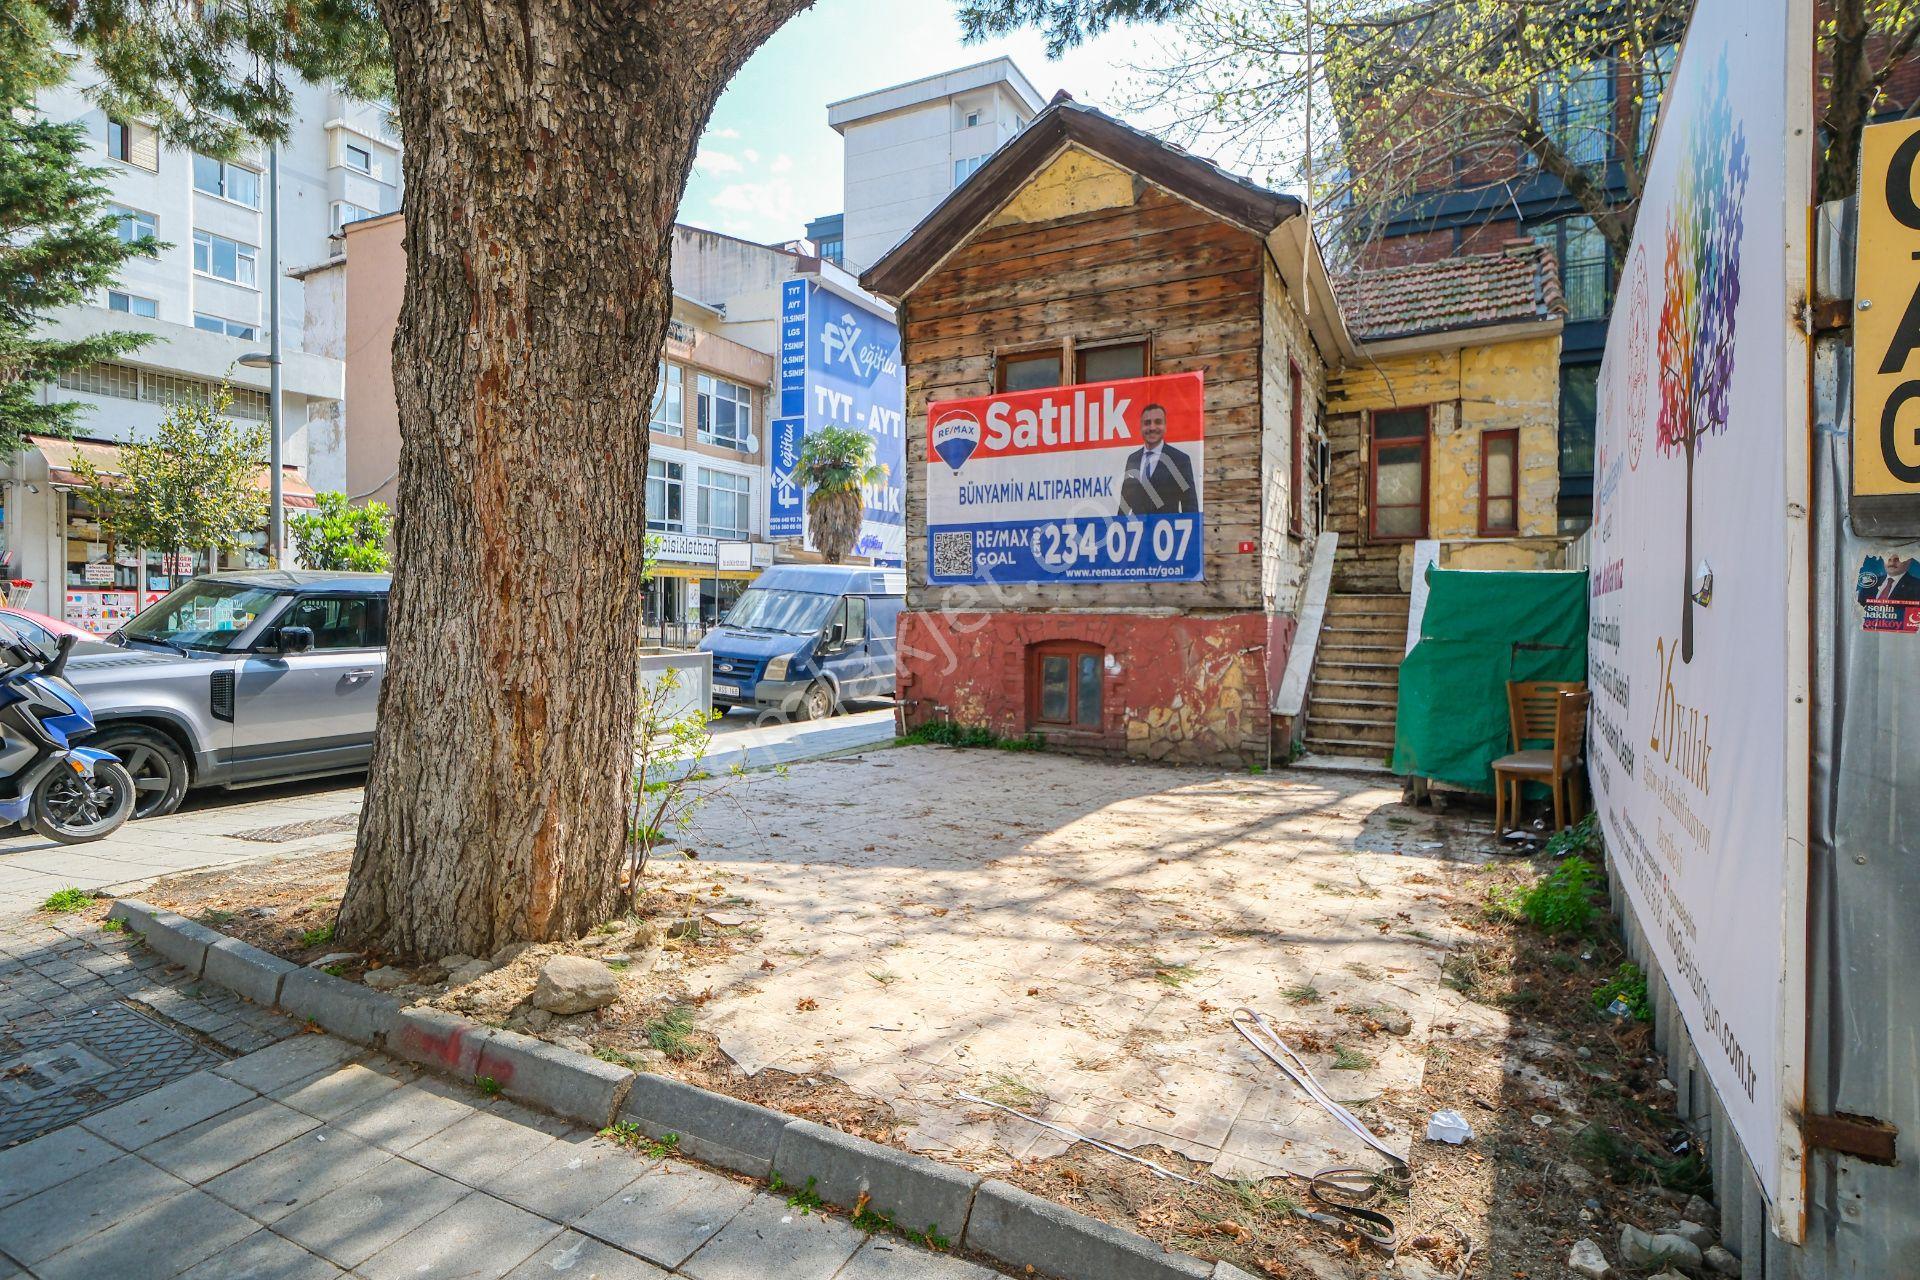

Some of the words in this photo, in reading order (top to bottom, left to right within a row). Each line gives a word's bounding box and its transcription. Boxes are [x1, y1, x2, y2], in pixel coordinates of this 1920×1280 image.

[787, 286, 800, 296] TYT
[787, 300, 800, 310] AYT
[788, 327, 801, 337] LGS
[860, 343, 898, 378] eğitim
[814, 384, 853, 424] TYT
[868, 404, 901, 438] AYT
[984, 387, 1132, 451] Satılık
[938, 424, 975, 439] RE/MAX
[959, 478, 1024, 506] BÜNYAMİN
[1027, 476, 1113, 502] ALTIPARMAK
[976, 528, 1029, 549] RE/MAX
[1044, 523, 1098, 565] 234
[1106, 521, 1144, 563] 07
[1153, 519, 1193, 562] 07
[976, 551, 1017, 566] GOAL
[1066, 565, 1184, 578] www.remax.com.tr/goal
[1867, 604, 1895, 613] senin
[1864, 618, 1903, 629] adıköy
[1650, 636, 1678, 764] 26
[1674, 703, 1712, 797] Yıllık
